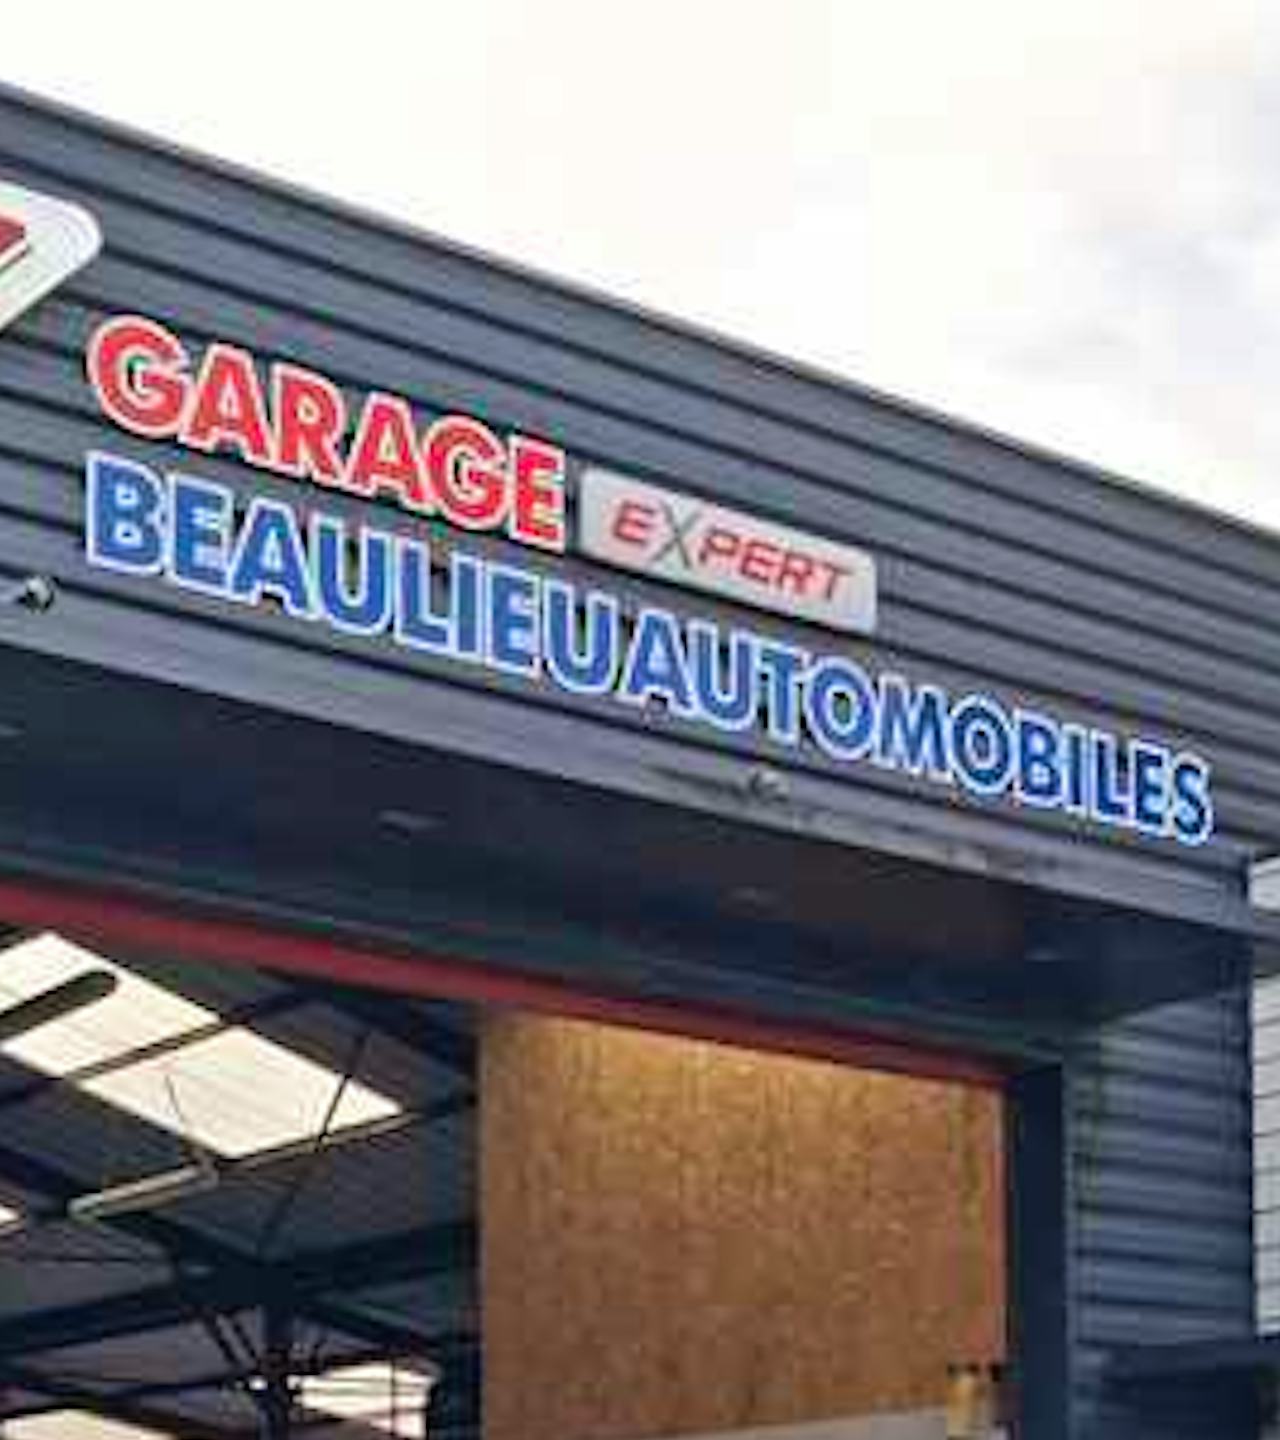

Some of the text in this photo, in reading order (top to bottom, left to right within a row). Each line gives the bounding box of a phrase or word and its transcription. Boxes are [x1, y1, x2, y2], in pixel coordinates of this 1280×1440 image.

[85, 314, 857, 607] GARAGE EXPERT
[83, 449, 1216, 849] BEAULIEU AUTOMOBILES
